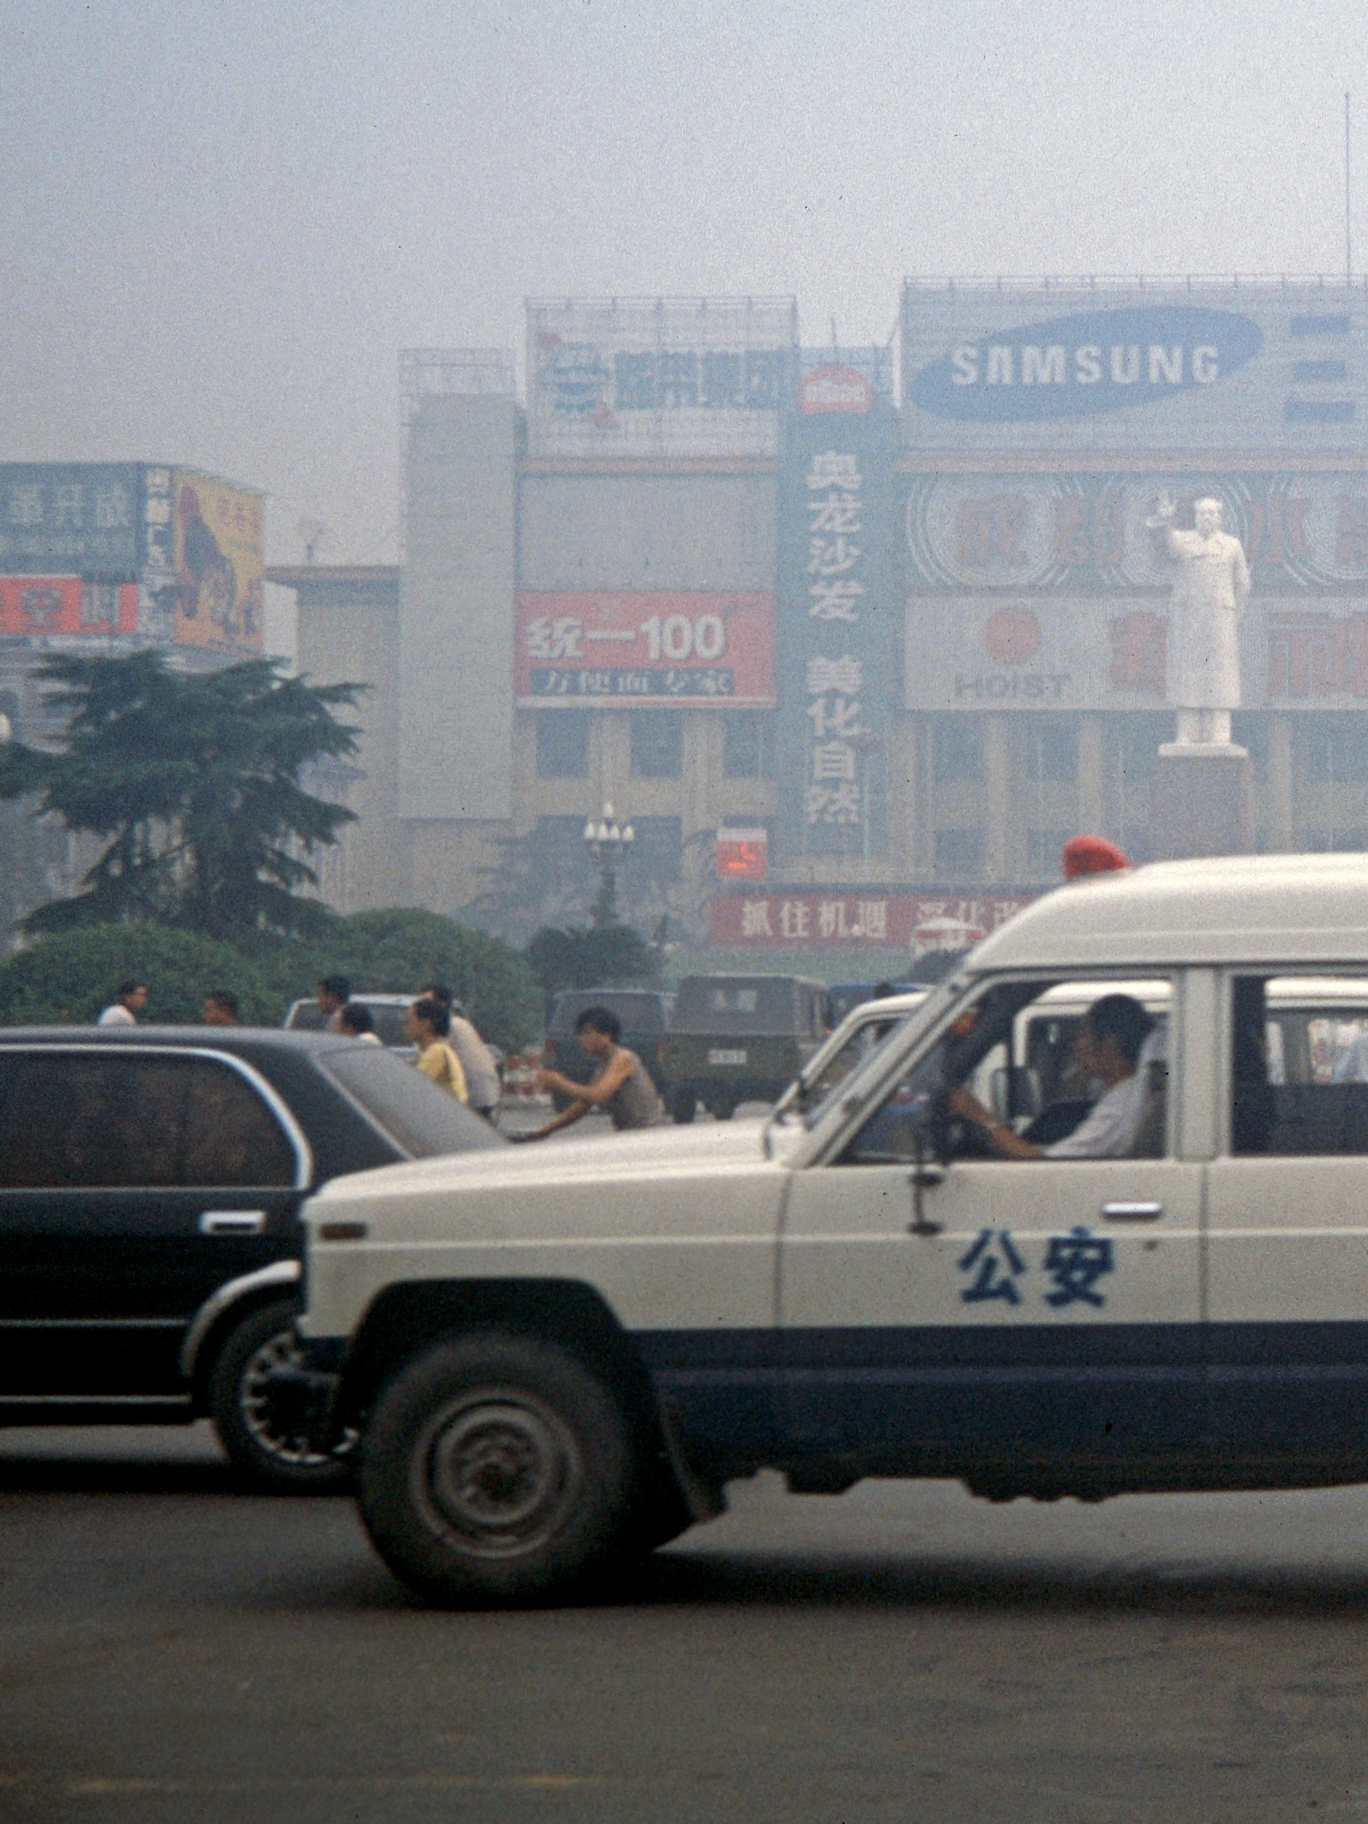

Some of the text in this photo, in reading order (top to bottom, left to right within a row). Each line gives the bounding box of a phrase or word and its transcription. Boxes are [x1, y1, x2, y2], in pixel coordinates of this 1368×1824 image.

[950, 344, 1219, 386] SAMSUNG
[804, 450, 867, 623] 奥龙沙发
[524, 614, 727, 662] 统一100
[954, 673, 1071, 699] HOIST
[804, 655, 871, 826] 美化自然
[742, 900, 889, 939] 抓住机遇
[957, 1225, 1115, 1308] 公安
